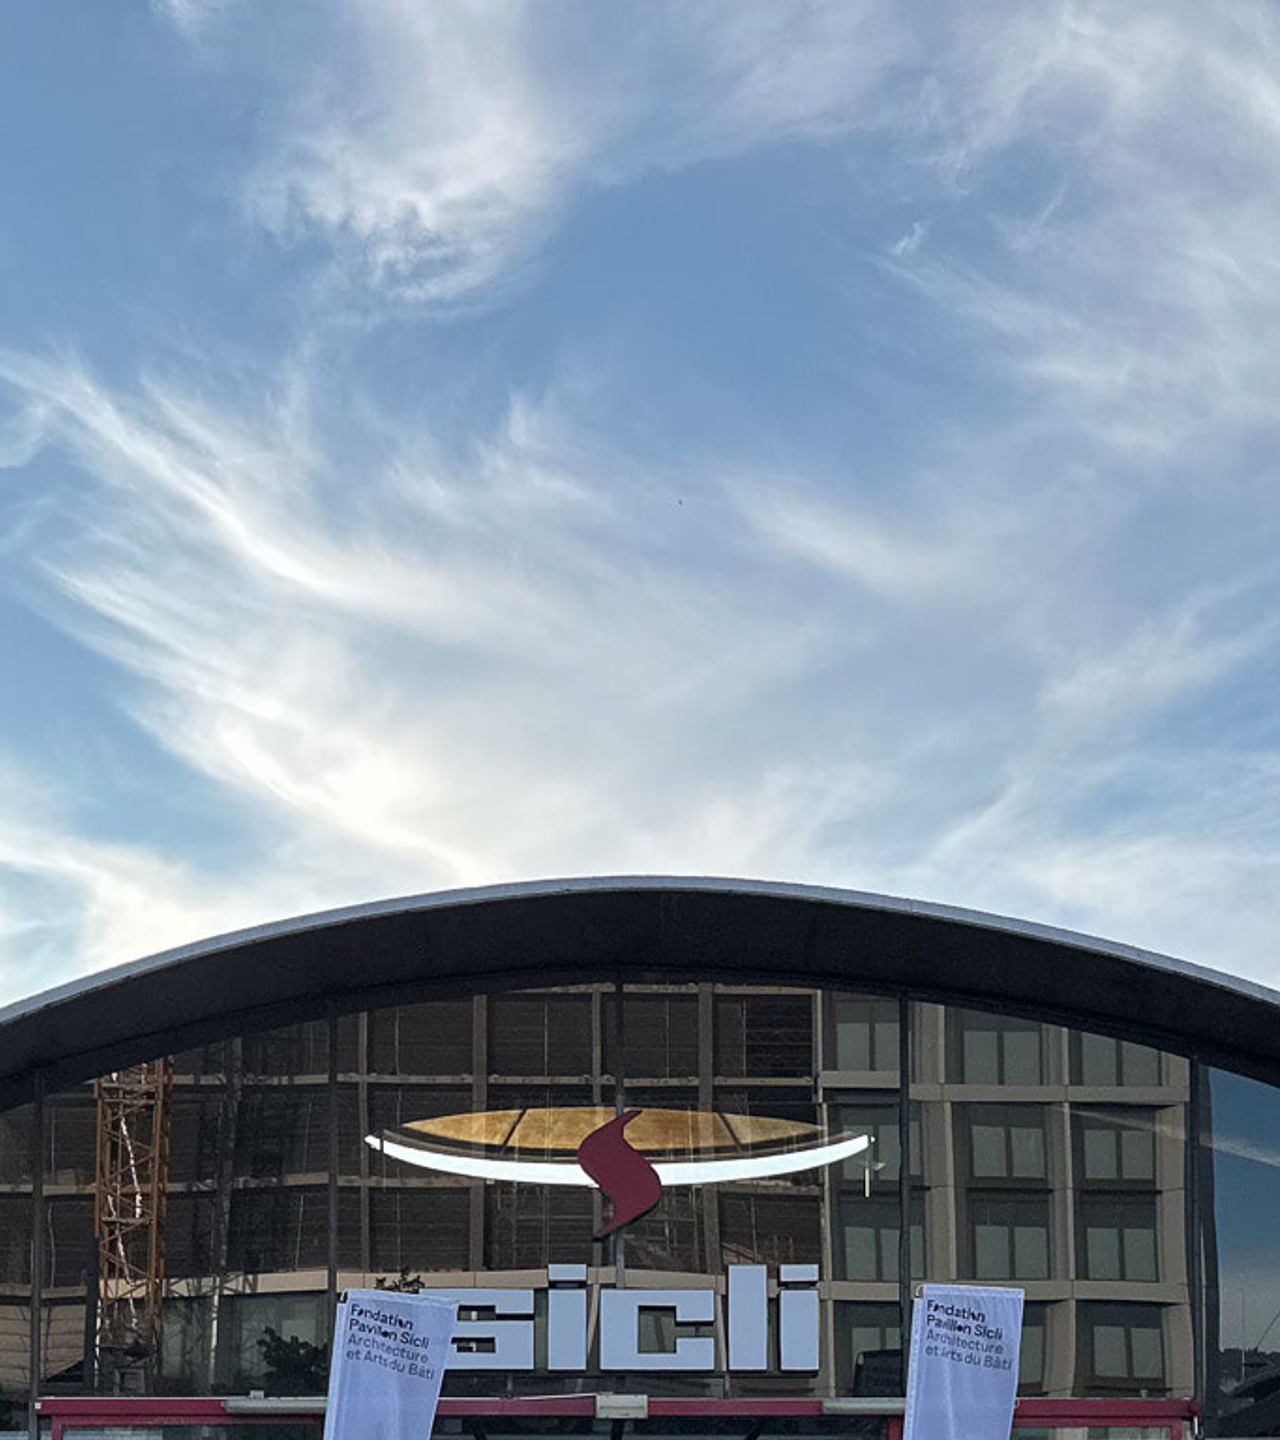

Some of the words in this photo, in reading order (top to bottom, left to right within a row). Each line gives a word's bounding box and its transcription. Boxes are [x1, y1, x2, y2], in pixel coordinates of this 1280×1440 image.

[351, 1303, 414, 1330] Fondation
[419, 1263, 820, 1371] sicli
[927, 1299, 986, 1323] Fondation
[348, 1318, 398, 1342] Pavillon
[399, 1331, 430, 1350] Sicli
[926, 1314, 972, 1335] Pavillon
[973, 1323, 1003, 1341] Sicli
[347, 1333, 429, 1364] Architecture
[925, 1329, 1005, 1355] Architecture
[345, 1349, 361, 1361] et
[363, 1350, 388, 1368] Arts
[389, 1359, 406, 1373] du
[925, 1346, 939, 1357] et
[964, 1352, 981, 1367] du
